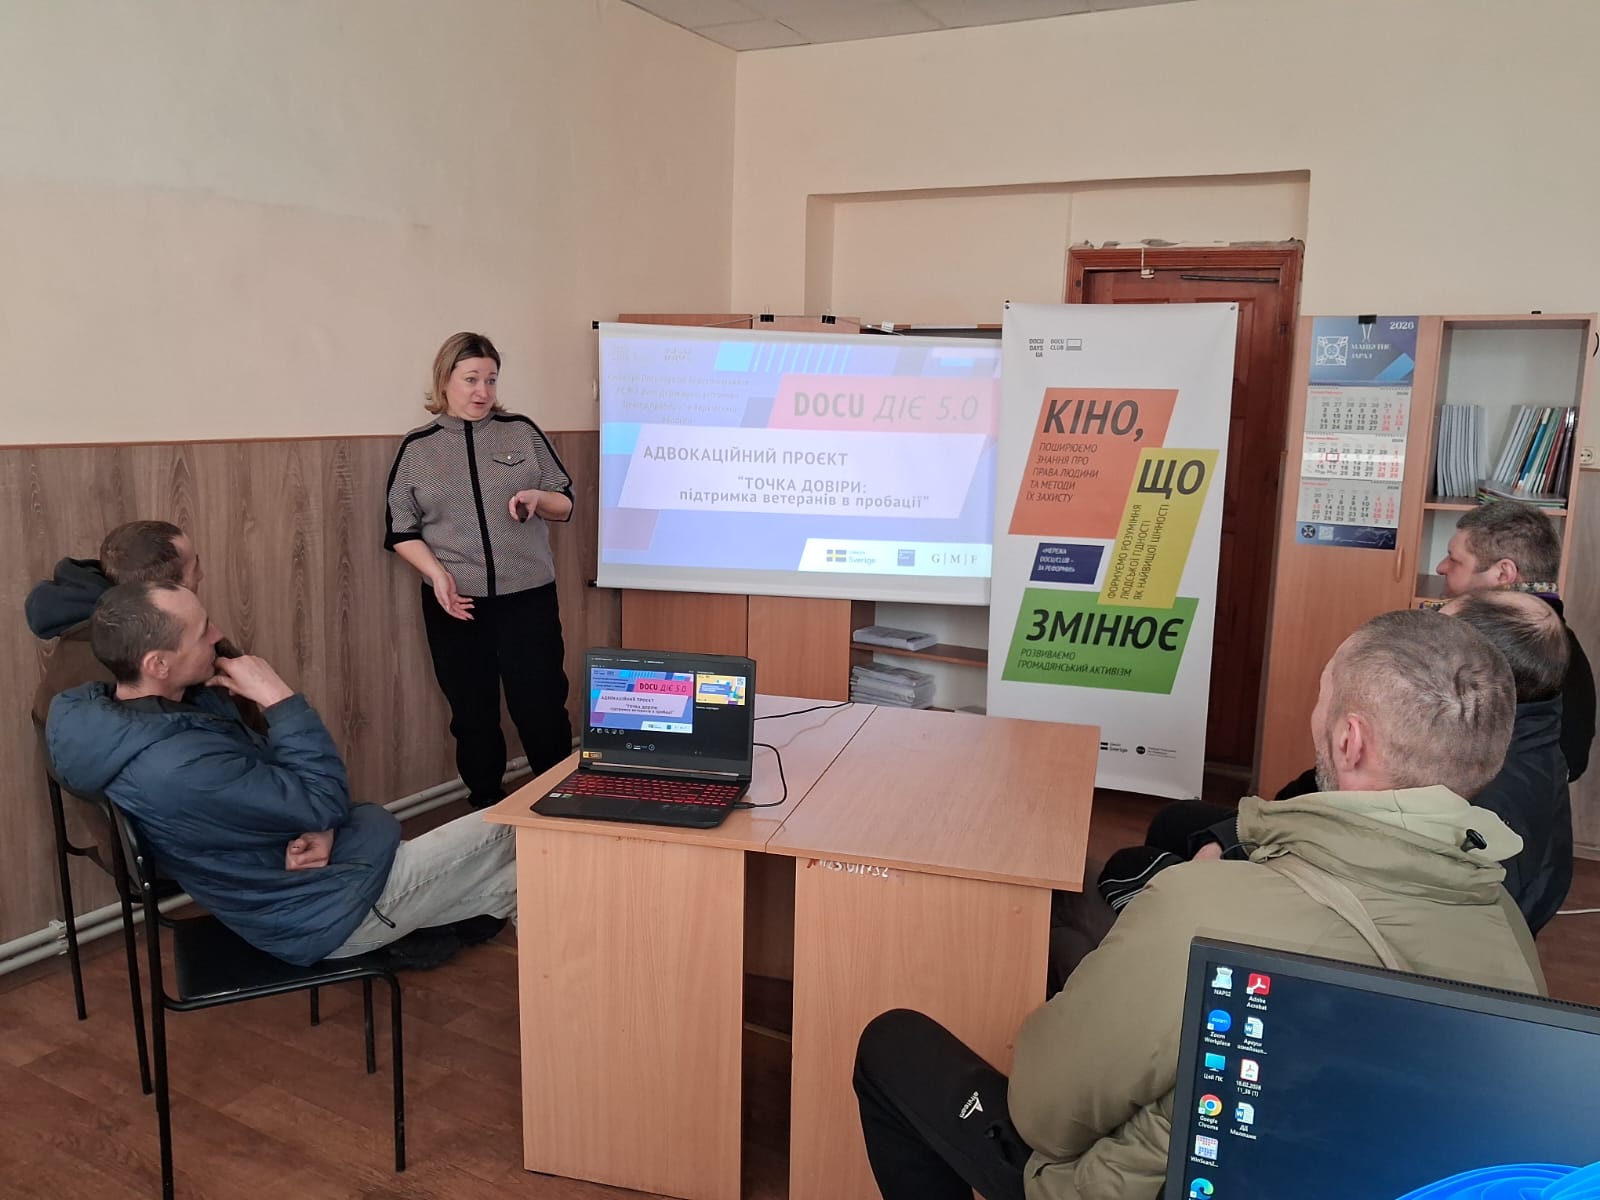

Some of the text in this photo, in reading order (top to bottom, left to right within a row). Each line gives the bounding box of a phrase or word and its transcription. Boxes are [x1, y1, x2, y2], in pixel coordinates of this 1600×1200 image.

[793, 391, 979, 423] DOCU ДІЄ 5.0
[1043, 399, 1144, 442] КІНО,
[1039, 442, 1098, 453] ПОШИРЮЄМО
[643, 445, 848, 466] АДВОКАЦІЙНИЙ ПРОЄКТ
[1036, 454, 1089, 466] ЗНАННЯ ПРО
[1032, 467, 1099, 479] ПРАВА ЛЮДИНИ
[1137, 459, 1206, 500] ЩО
[801, 479, 867, 494] ДОВІРИ:
[1030, 480, 1076, 491] ТА МЕТОДИ
[679, 488, 757, 504] підтримка
[763, 492, 836, 508] ветеранів
[841, 497, 850, 506] в
[1025, 490, 1074, 503] ЇХ ЗАХИСТУ
[1107, 504, 1142, 599] ФОРМУЄМО РОЗУМІННЯ
[1133, 504, 1171, 600] ЯК НАЙВИЩОЇ ЦІННОСТІ
[849, 555, 877, 565] Sverige
[1120, 520, 1151, 600] ЛЮДСЬКОЇ ГІДНОСТІ
[1025, 608, 1184, 652] ЗМІНЮЄ
[1020, 648, 1076, 661] РОЗВИВАЄМО
[1017, 660, 1132, 677] ГРОМАДЯНСЬКИЙ АКТИВІЗМ
[640, 682, 658, 691] DOCU
[1246, 1002, 1267, 1011] Acrobat
[1248, 996, 1266, 1004] Adobe
[1210, 1031, 1226, 1039] Zoom
[1204, 1037, 1231, 1047] Workplace
[1198, 1122, 1219, 1131] Chrome
[1200, 1115, 1218, 1125] Google
